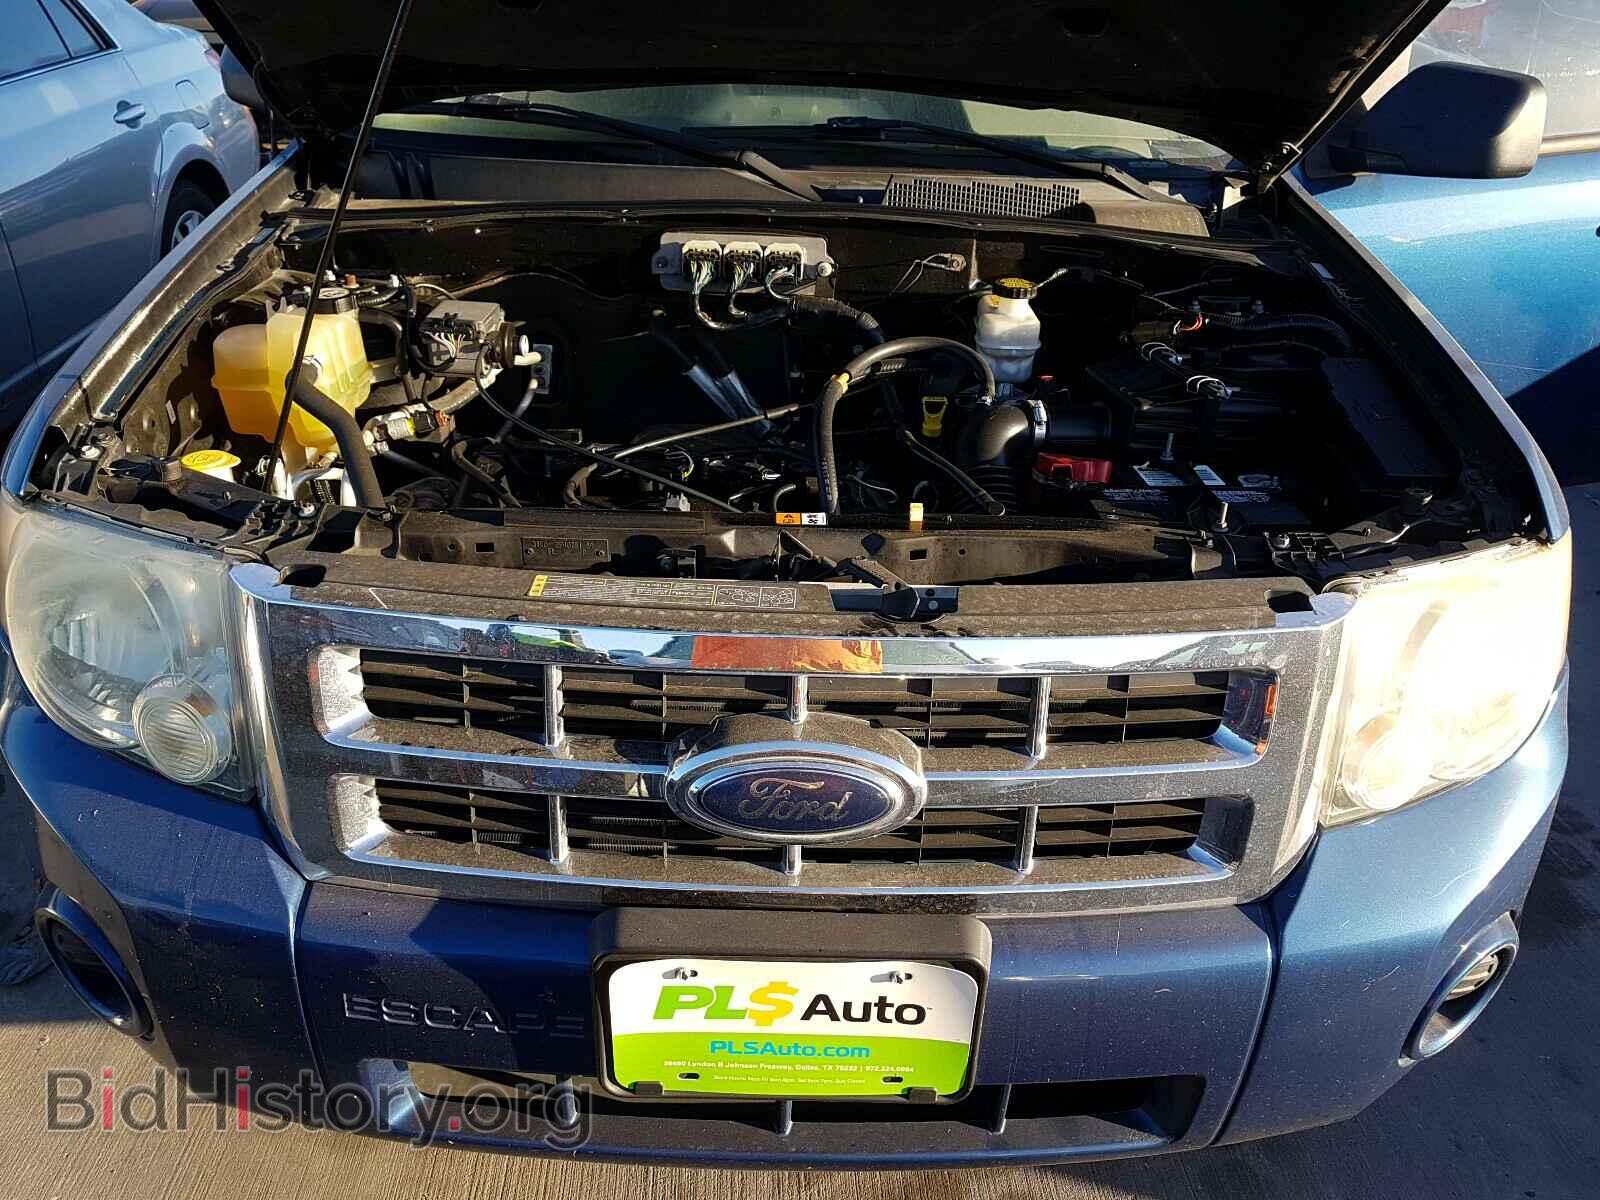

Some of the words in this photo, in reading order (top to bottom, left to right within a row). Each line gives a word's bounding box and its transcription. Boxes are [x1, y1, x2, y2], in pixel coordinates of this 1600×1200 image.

[738, 777, 853, 821] Ford
[343, 993, 585, 1038] ESCAPE
[800, 993, 927, 1025] Auto
[709, 1039, 871, 1058] PLSAuto.com
